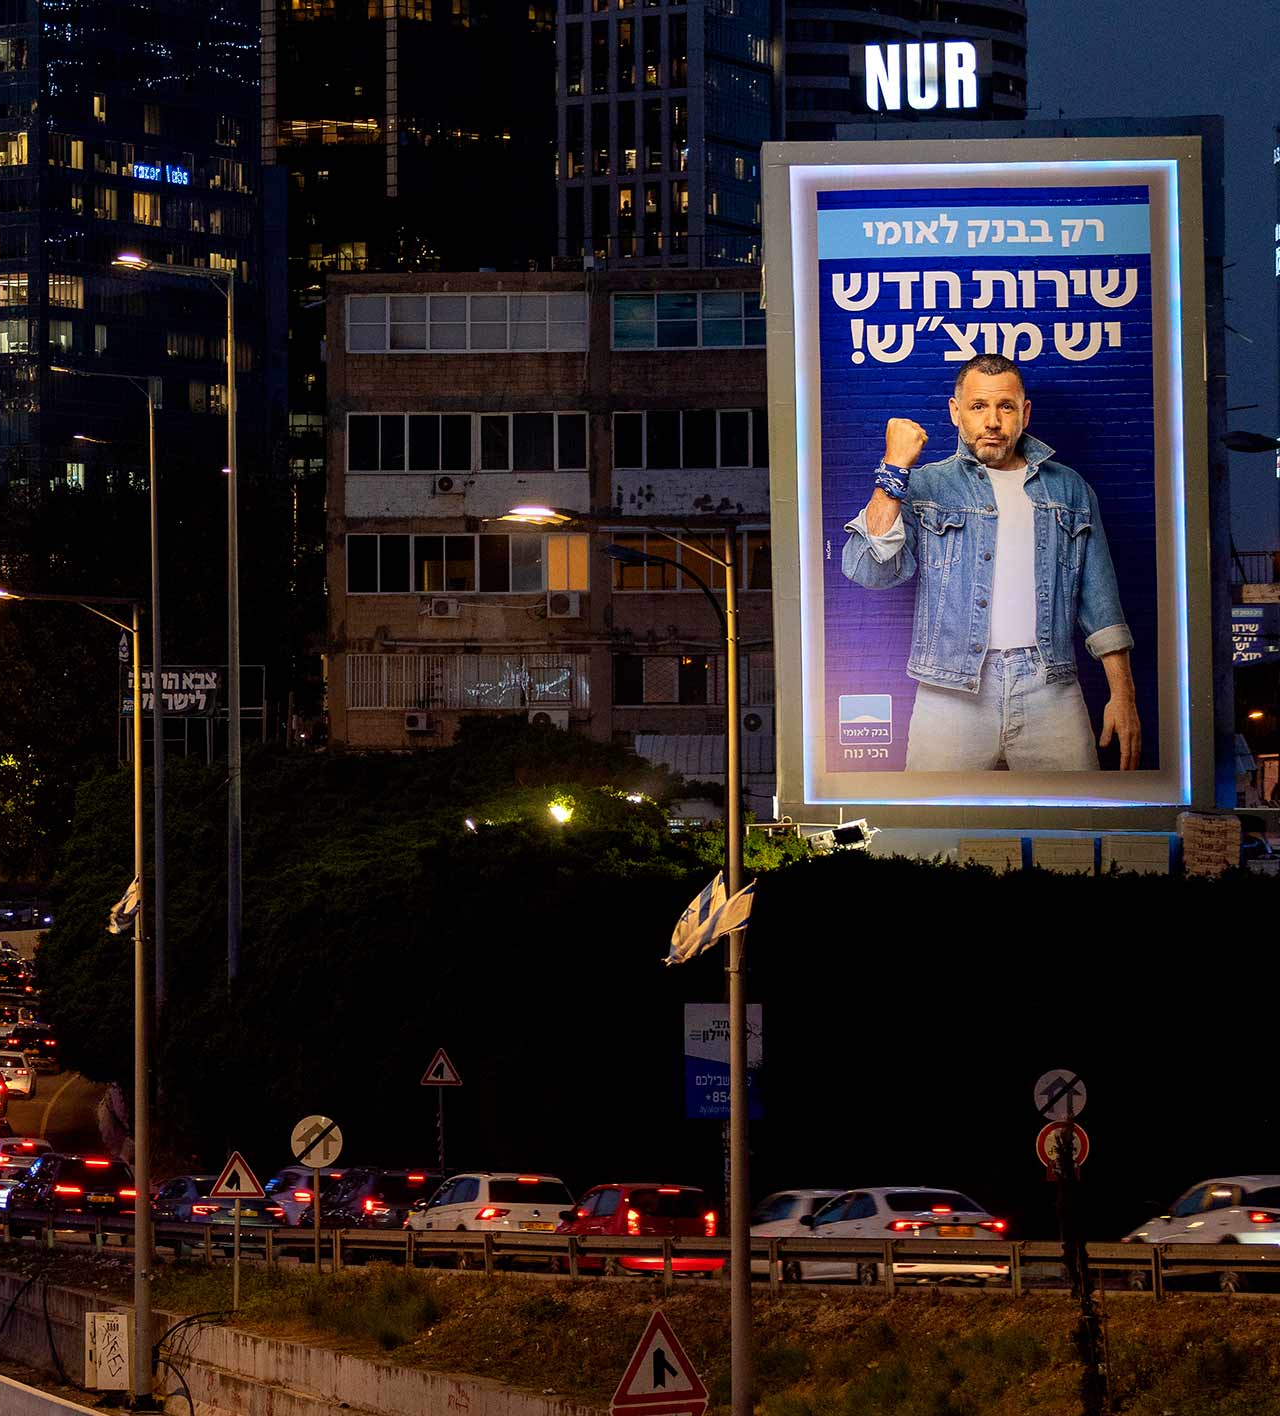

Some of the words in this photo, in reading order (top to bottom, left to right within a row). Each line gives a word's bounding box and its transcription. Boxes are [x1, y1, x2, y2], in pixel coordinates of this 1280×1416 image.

[866, 42, 977, 110] NUR
[863, 214, 958, 244] לאומי
[968, 220, 1053, 247] בבנק
[1060, 219, 1104, 247] רק
[832, 271, 961, 310] חדש
[973, 269, 1138, 309] שירות
[1053, 321, 1122, 360] יש
[182, 671, 217, 689] צבא
[843, 728, 870, 737] לאומי
[871, 729, 889, 738] בנק
[844, 749, 864, 759] נוח
[867, 748, 889, 758] הכי
